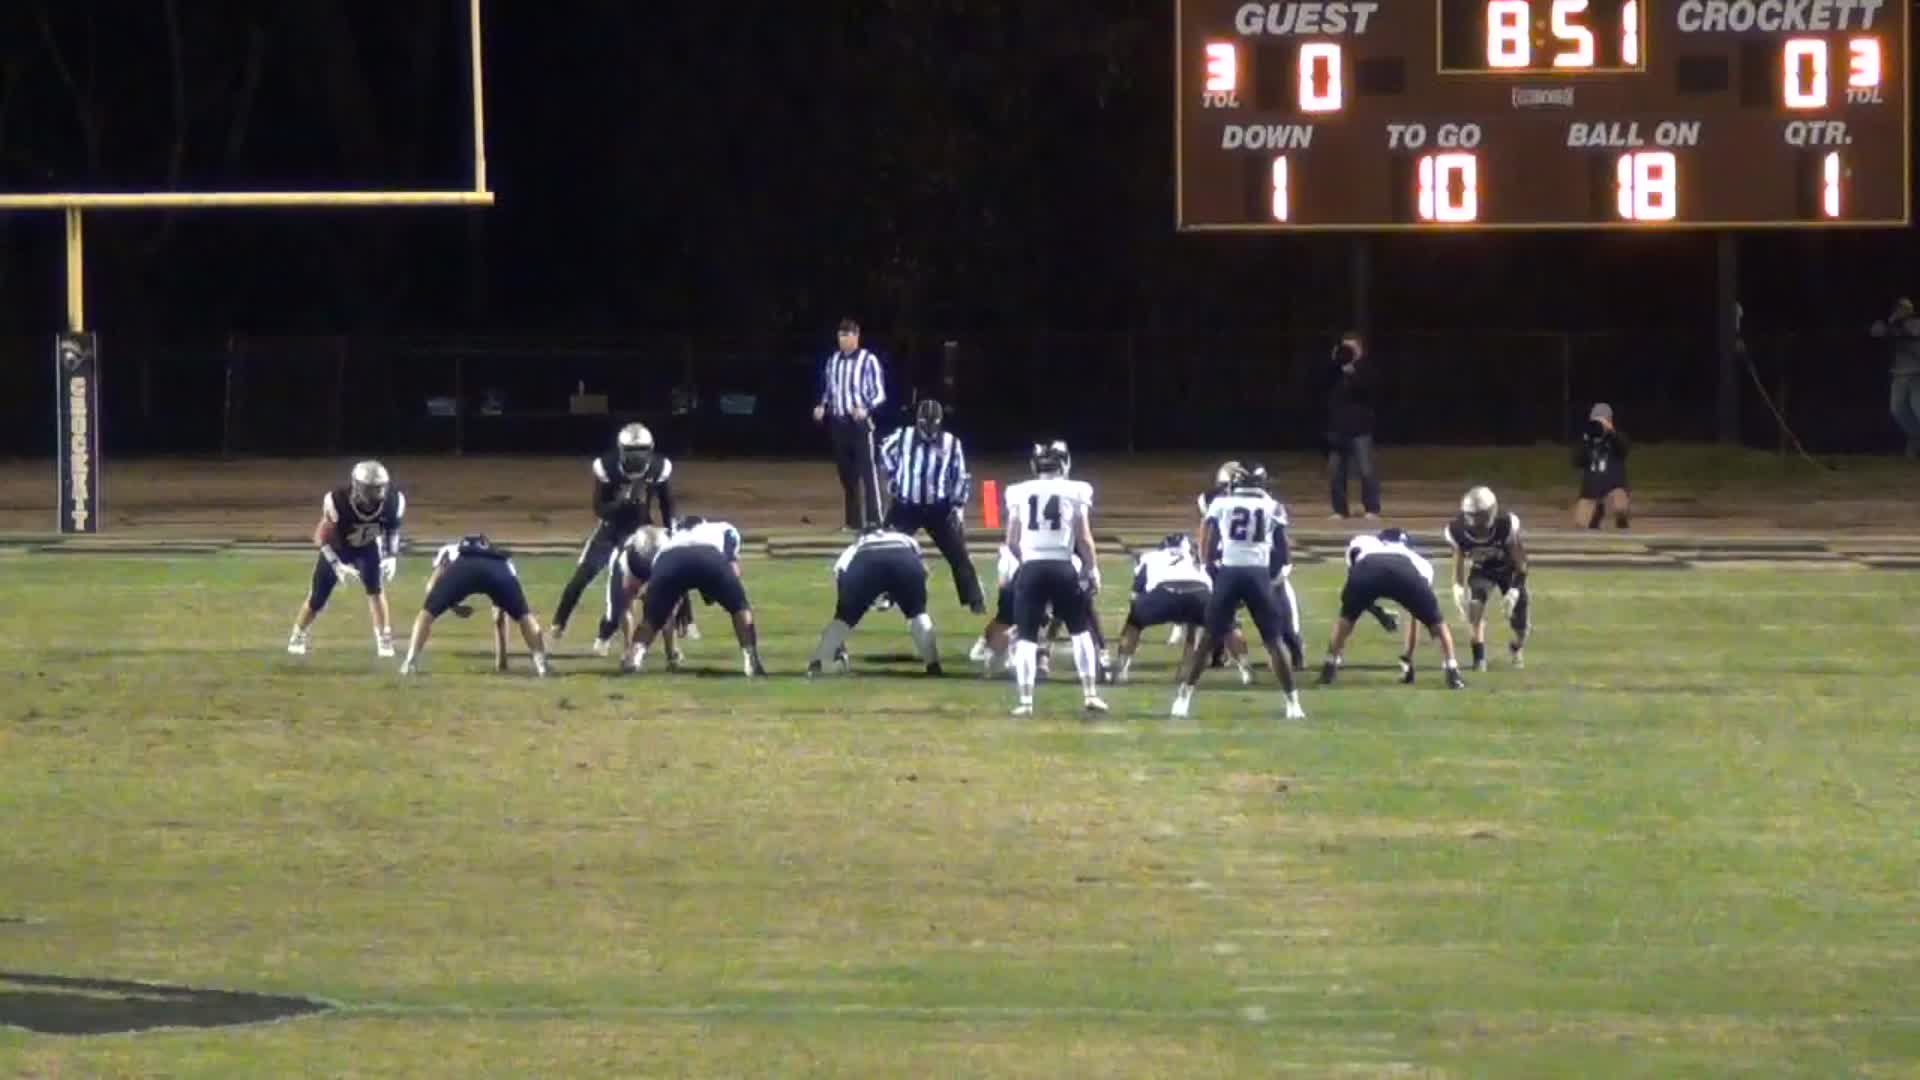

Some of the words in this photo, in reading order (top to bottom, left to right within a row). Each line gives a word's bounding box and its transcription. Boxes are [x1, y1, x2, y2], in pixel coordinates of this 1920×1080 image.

[1235, 2, 1378, 34] GUEST
[1487, 0, 1637, 67] 8:51
[1677, 0, 1883, 32] CROCKETT
[1206, 43, 1236, 91] 3
[1299, 43, 1342, 110] 0
[1784, 39, 1827, 107] 0
[1848, 38, 1880, 86] 3
[1202, 91, 1240, 108] TOL
[1222, 125, 1313, 148] DOWN
[1386, 124, 1426, 148] TO
[1437, 124, 1481, 148] GO
[1567, 122, 1645, 147] BALL
[1655, 122, 1701, 146] ON
[1784, 121, 1852, 147] QTR.
[1273, 155, 1288, 221] 1
[1418, 153, 1477, 221] 10
[1617, 152, 1676, 220] 18
[1824, 151, 1840, 217] 1
[1027, 494, 1062, 530] 14
[1229, 506, 1265, 543] 21
